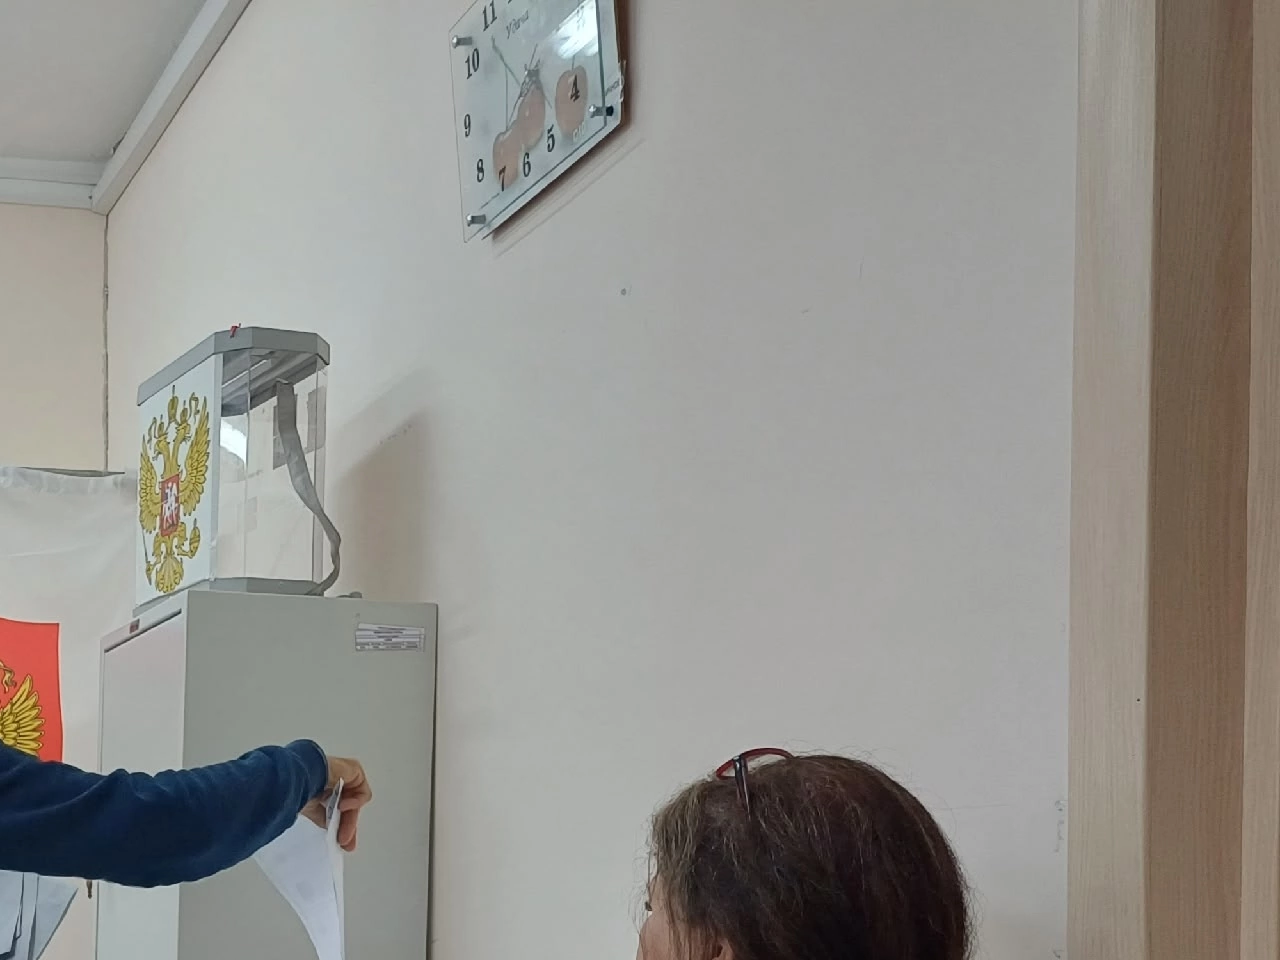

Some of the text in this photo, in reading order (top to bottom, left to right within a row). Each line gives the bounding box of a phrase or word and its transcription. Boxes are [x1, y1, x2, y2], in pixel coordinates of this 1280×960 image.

[482, 0, 498, 32] 11
[465, 48, 480, 80] 10
[570, 74, 580, 102] 4
[464, 113, 471, 138] 9
[547, 124, 555, 152] 5
[476, 158, 485, 183] 8
[522, 152, 531, 177] 6
[498, 165, 507, 192] 7
